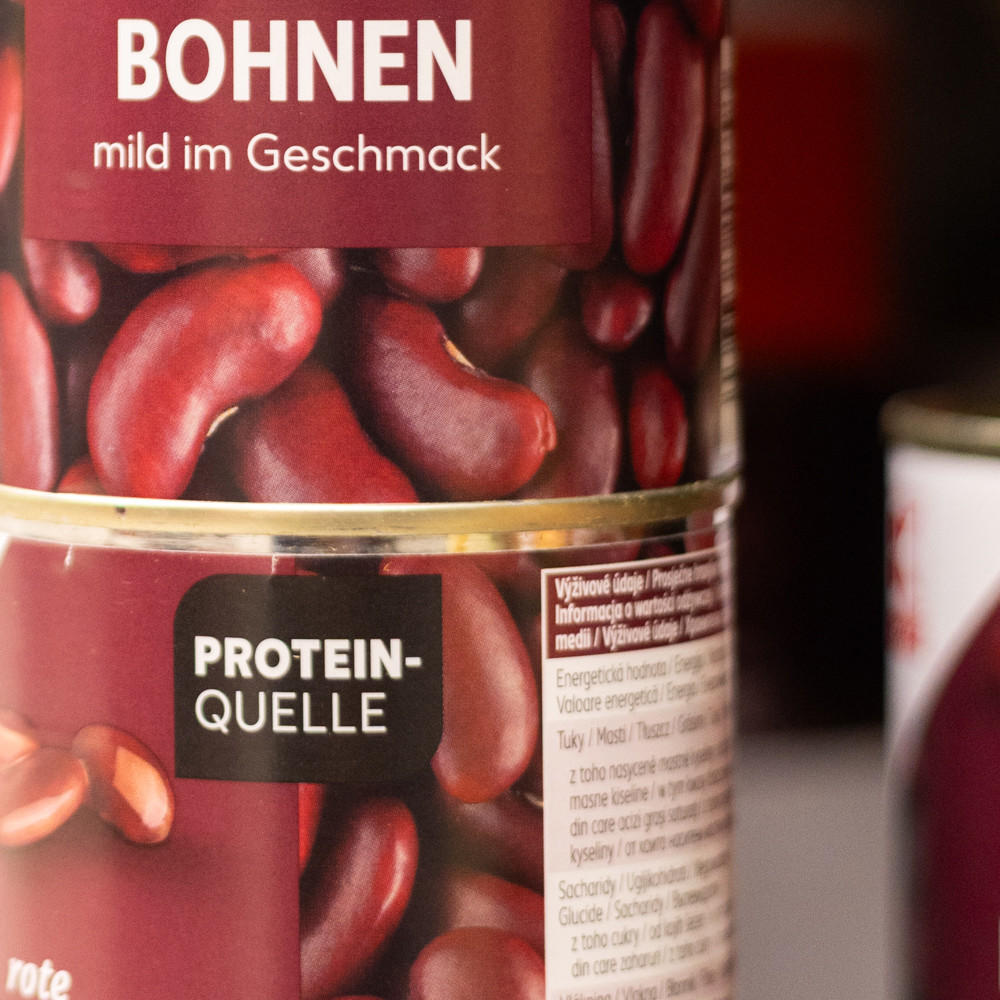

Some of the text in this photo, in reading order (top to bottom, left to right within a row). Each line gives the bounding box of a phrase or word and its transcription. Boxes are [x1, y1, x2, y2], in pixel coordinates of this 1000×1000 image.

[116, 18, 473, 102] BOHNEN
[93, 132, 502, 173] mild im Geschmack
[555, 573, 610, 603] Výživové
[613, 572, 643, 597] údaje
[555, 600, 622, 625] Informacja
[625, 604, 633, 619] o
[555, 626, 591, 650] medii
[194, 635, 422, 680] PROTEIN-
[557, 662, 624, 690] Energetická
[195, 688, 388, 734] QUELLE
[557, 695, 601, 714] Valoare
[558, 730, 584, 752] Tuky
[580, 762, 606, 782] toho
[570, 818, 588, 837] din
[591, 818, 615, 834] care
[559, 876, 616, 900] Sacharidy
[558, 904, 603, 926] Glucide
[581, 929, 608, 950] toho
[5, 957, 73, 1000] rote
[571, 959, 590, 978] din
[593, 958, 617, 975] care
